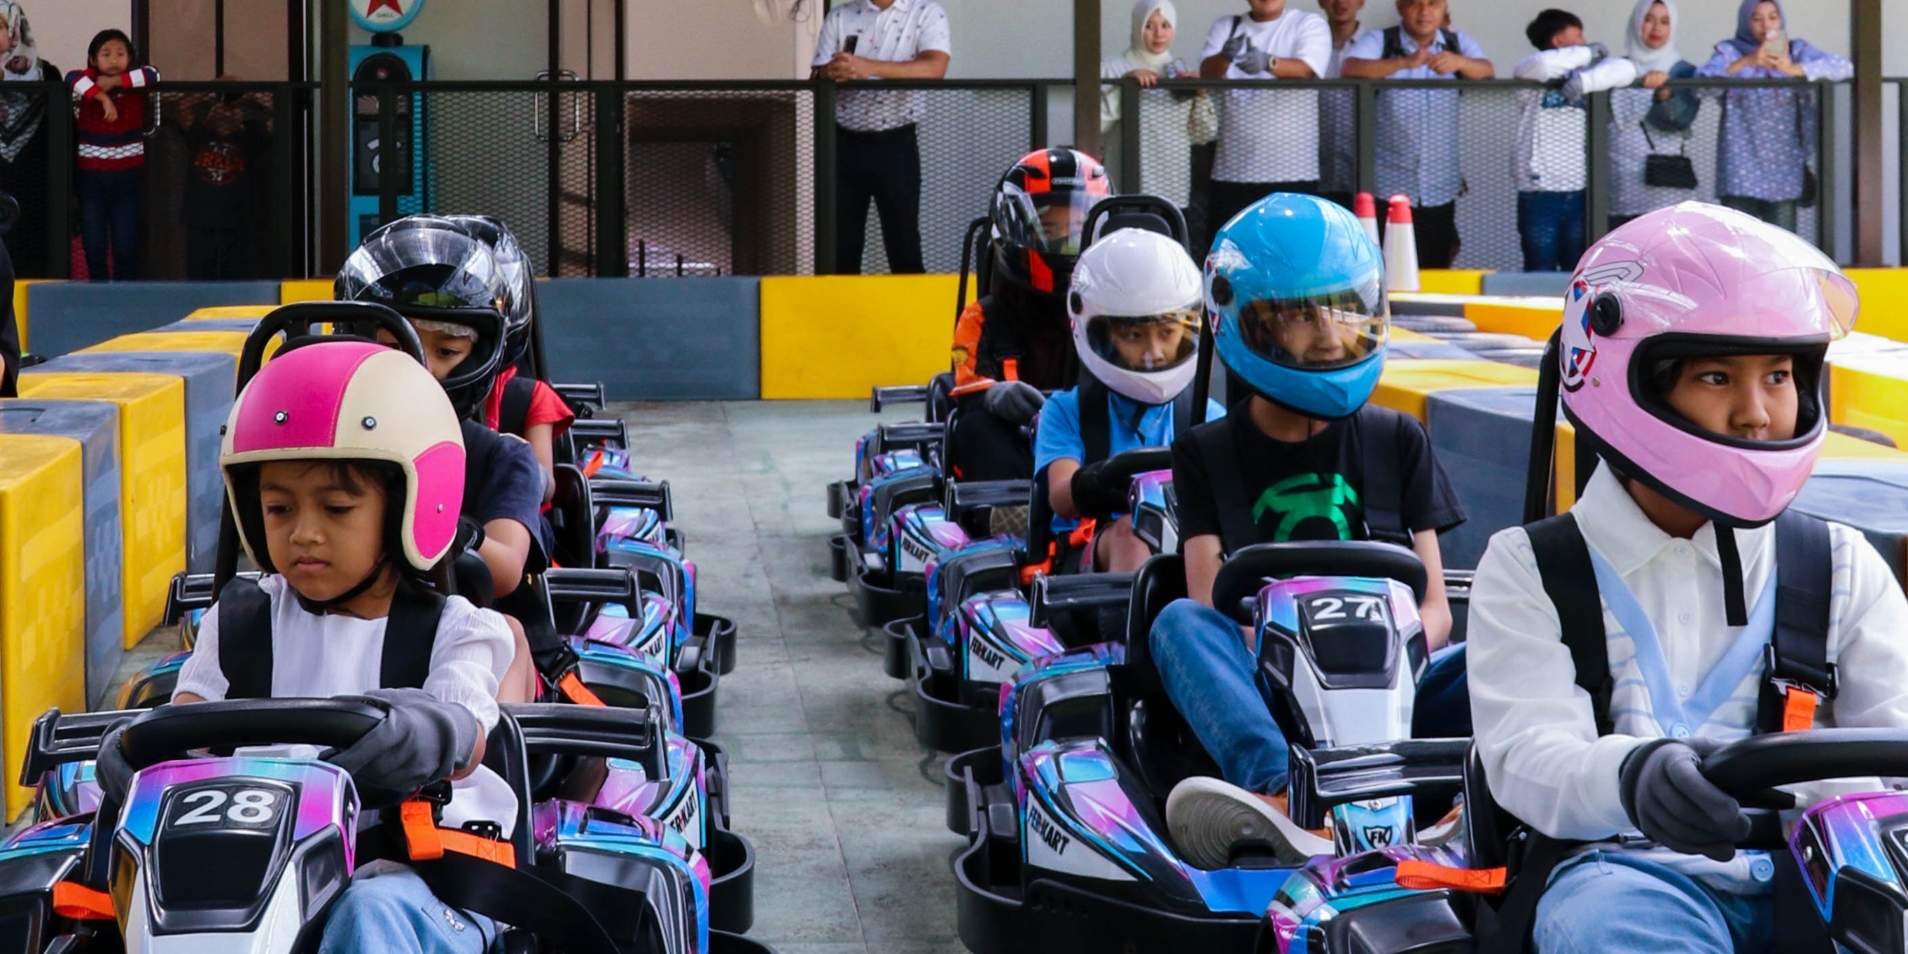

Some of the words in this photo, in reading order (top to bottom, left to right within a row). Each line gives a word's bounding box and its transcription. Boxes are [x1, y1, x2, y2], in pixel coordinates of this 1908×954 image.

[1311, 597, 1376, 619] 27
[174, 790, 274, 826] 28
[1370, 831, 1387, 844] FK
